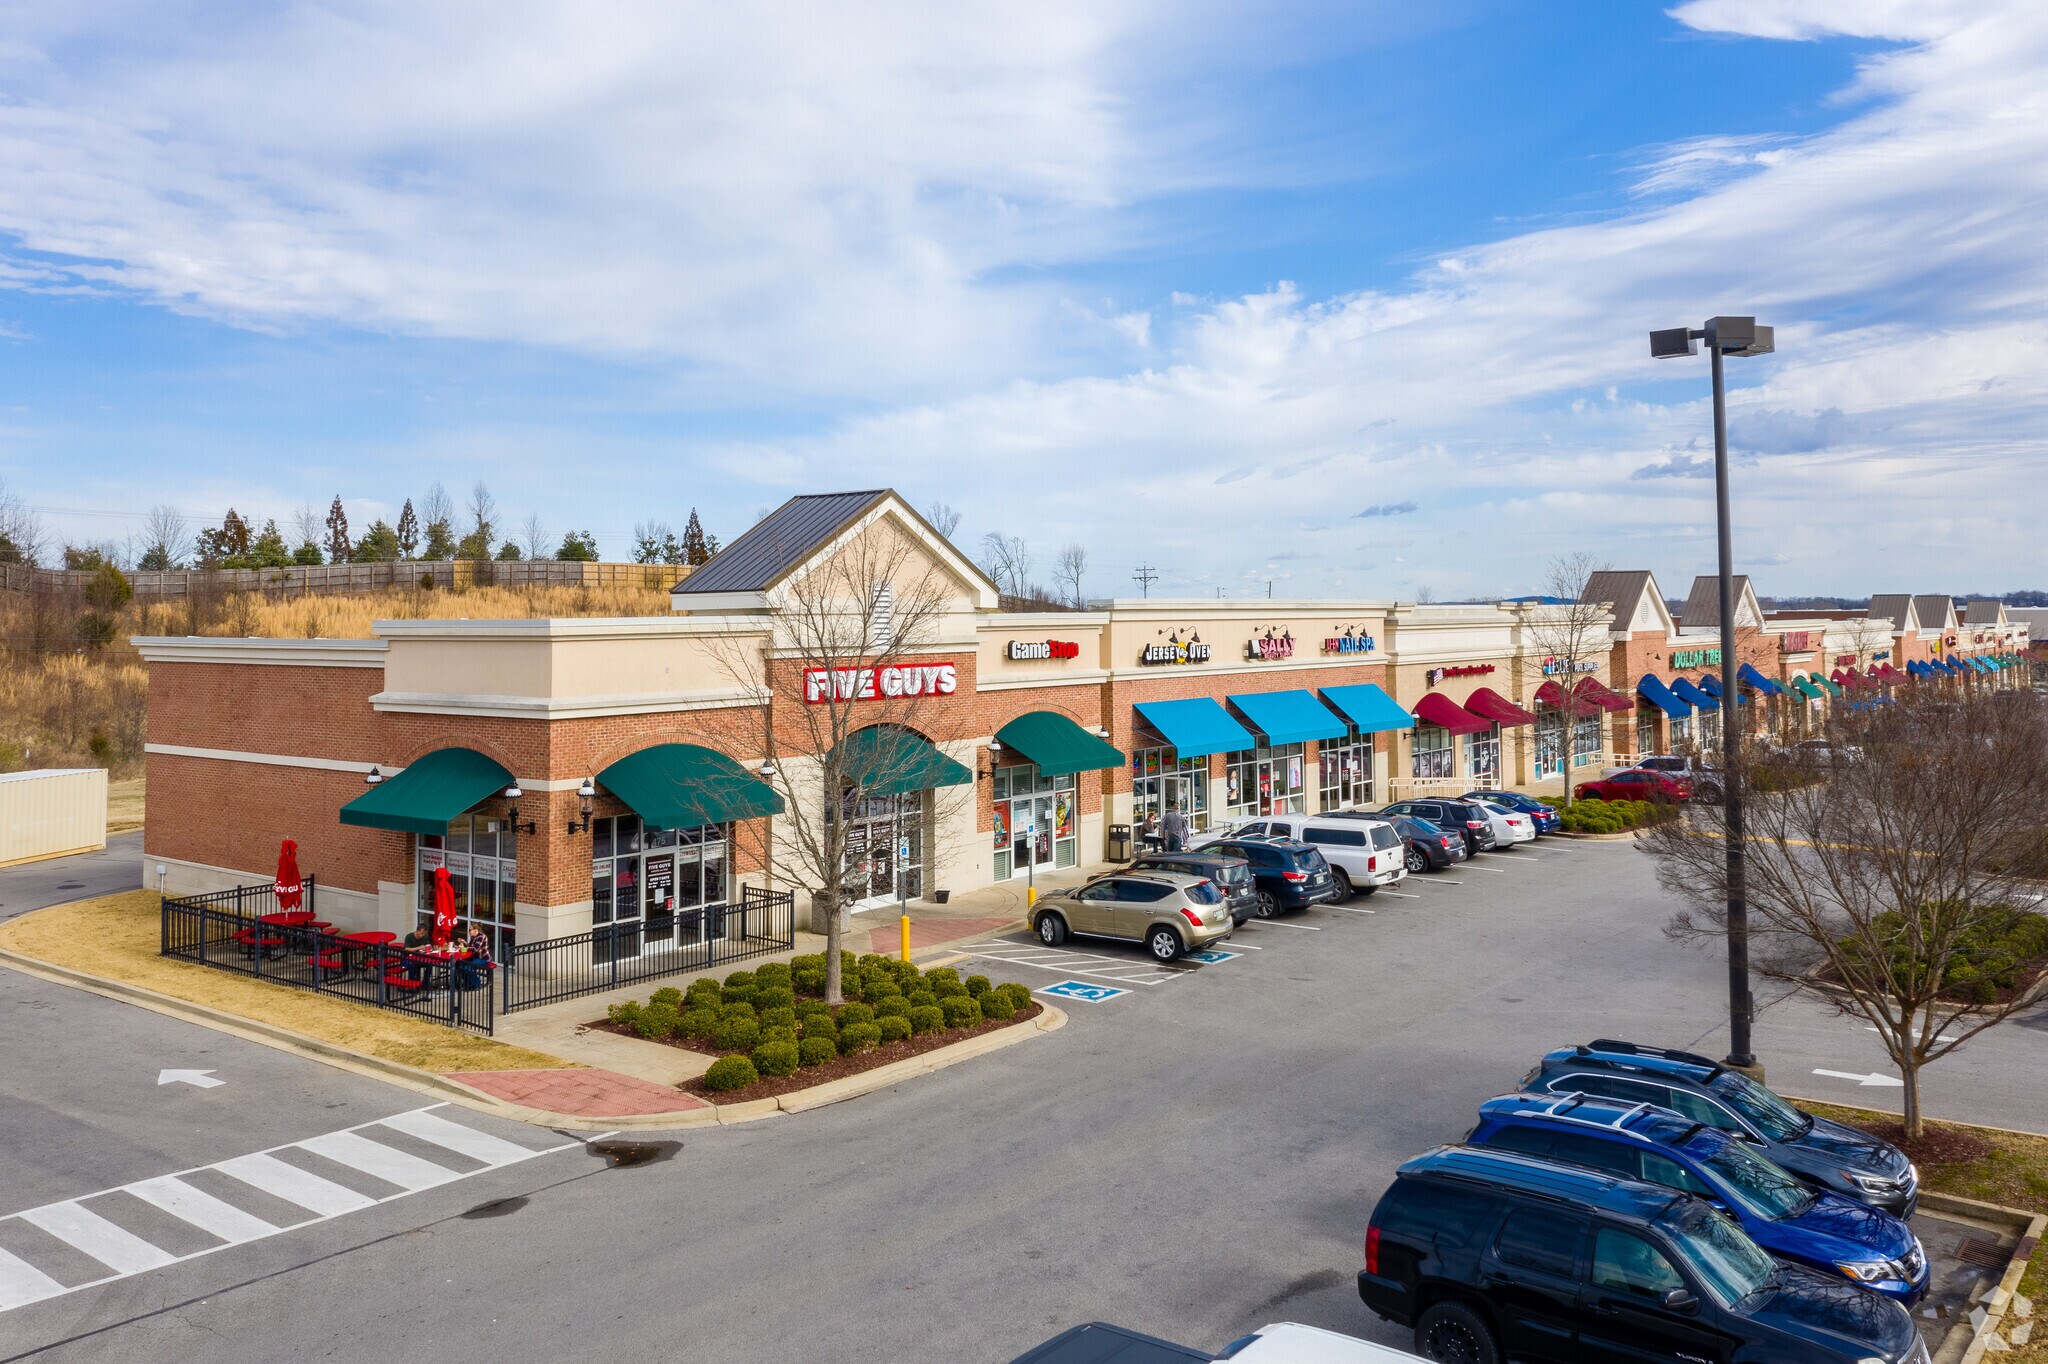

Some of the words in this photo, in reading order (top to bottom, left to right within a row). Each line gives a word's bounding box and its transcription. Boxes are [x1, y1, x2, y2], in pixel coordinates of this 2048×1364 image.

[1011, 640, 1079, 660] GameStop
[1189, 642, 1212, 659] OVEN
[1260, 638, 1297, 652] SALLY
[1340, 638, 1359, 650] NAIL
[1360, 637, 1375, 649] SPA
[1674, 650, 1704, 669] DOLLAR
[1705, 649, 1721, 666] TRE
[806, 670, 876, 701] FIVE
[879, 665, 957, 696] GUYS
